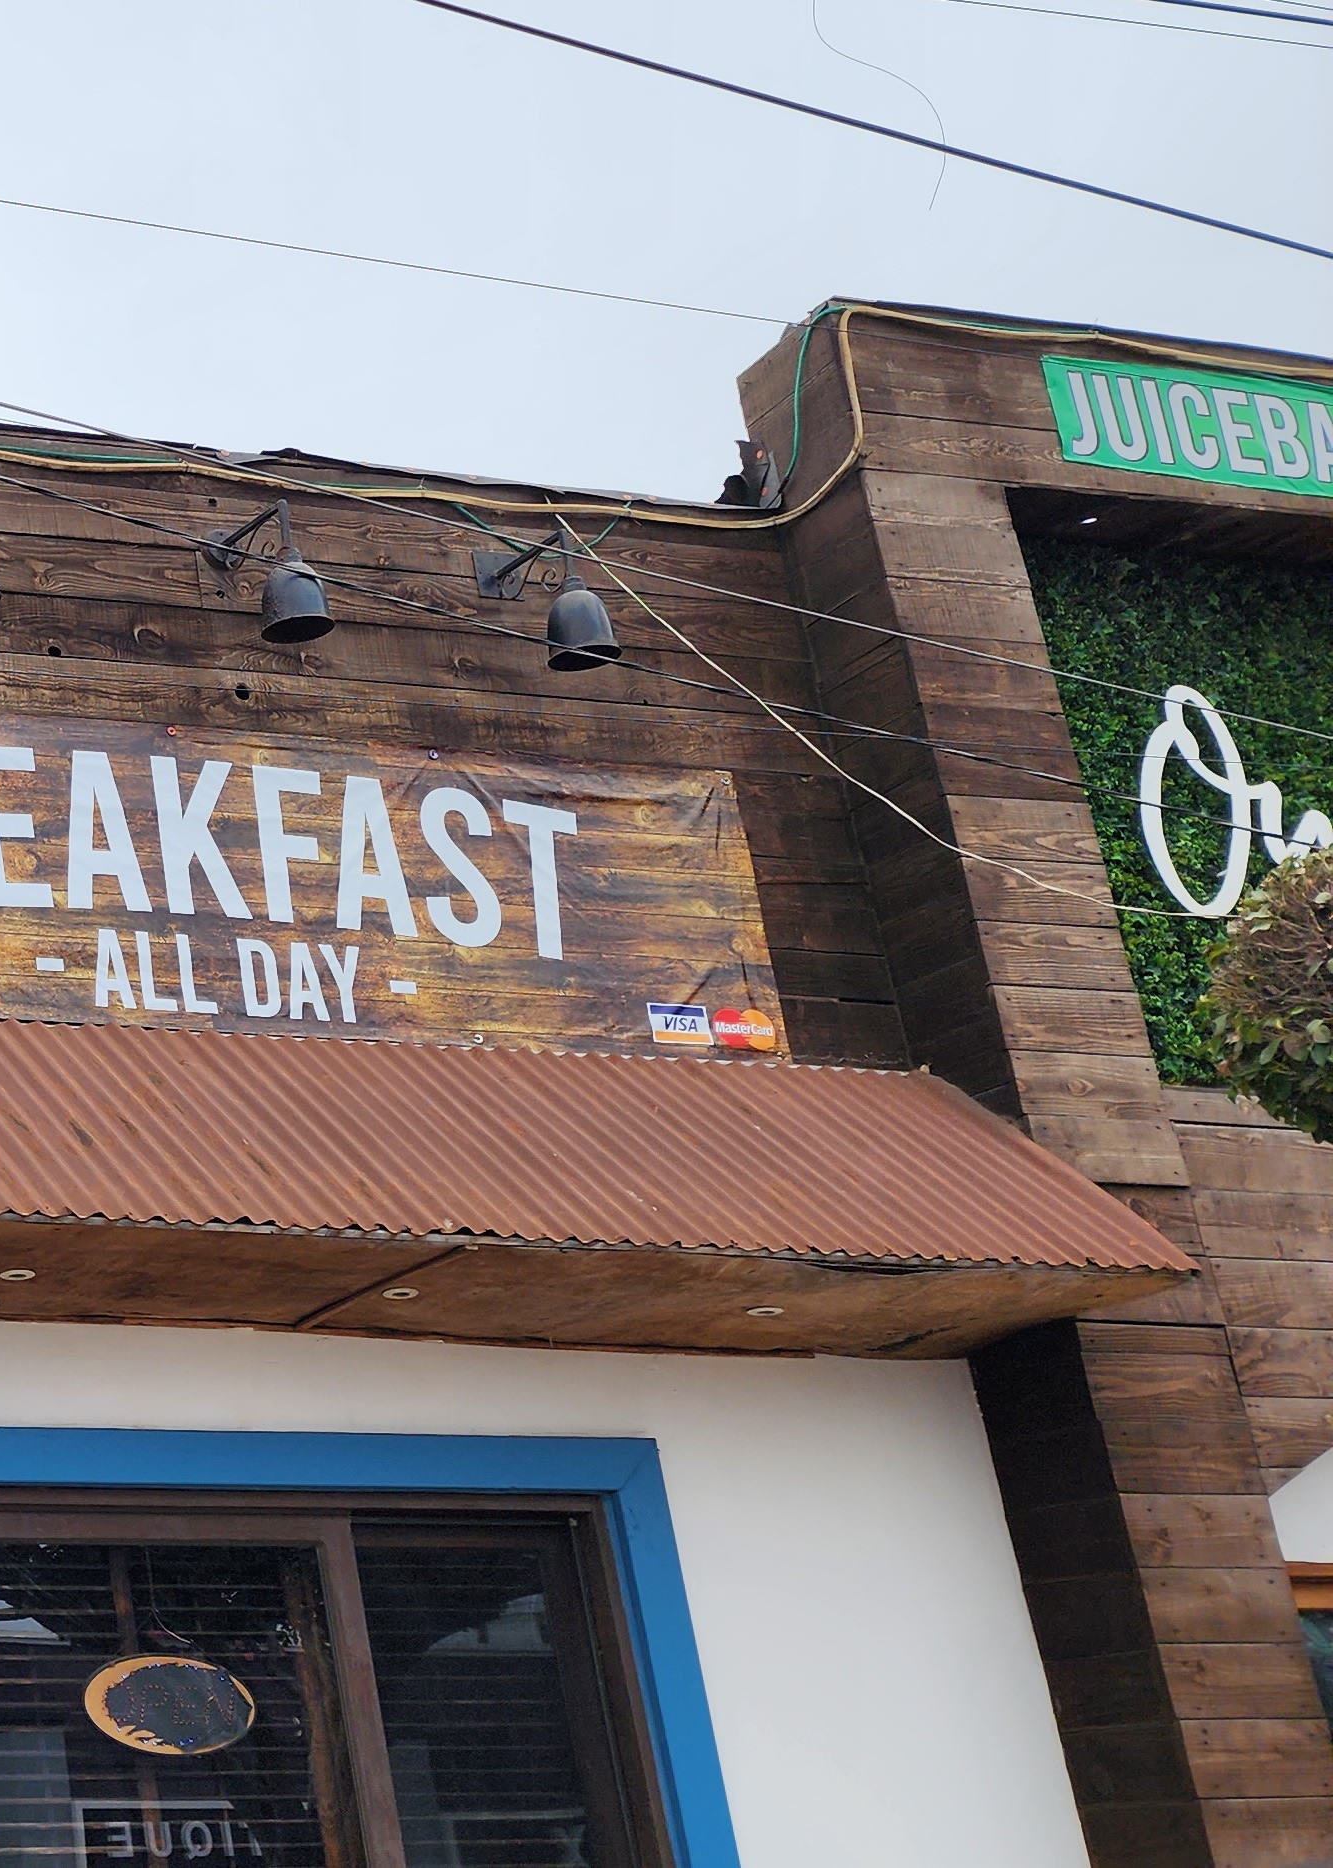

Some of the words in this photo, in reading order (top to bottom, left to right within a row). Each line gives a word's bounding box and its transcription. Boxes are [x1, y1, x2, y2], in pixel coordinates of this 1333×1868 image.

[95, 928, 219, 1014] ALL
[237, 939, 360, 1025] DAY
[663, 1015, 698, 1033] VISA
[714, 1021, 774, 1037] MasterCard
